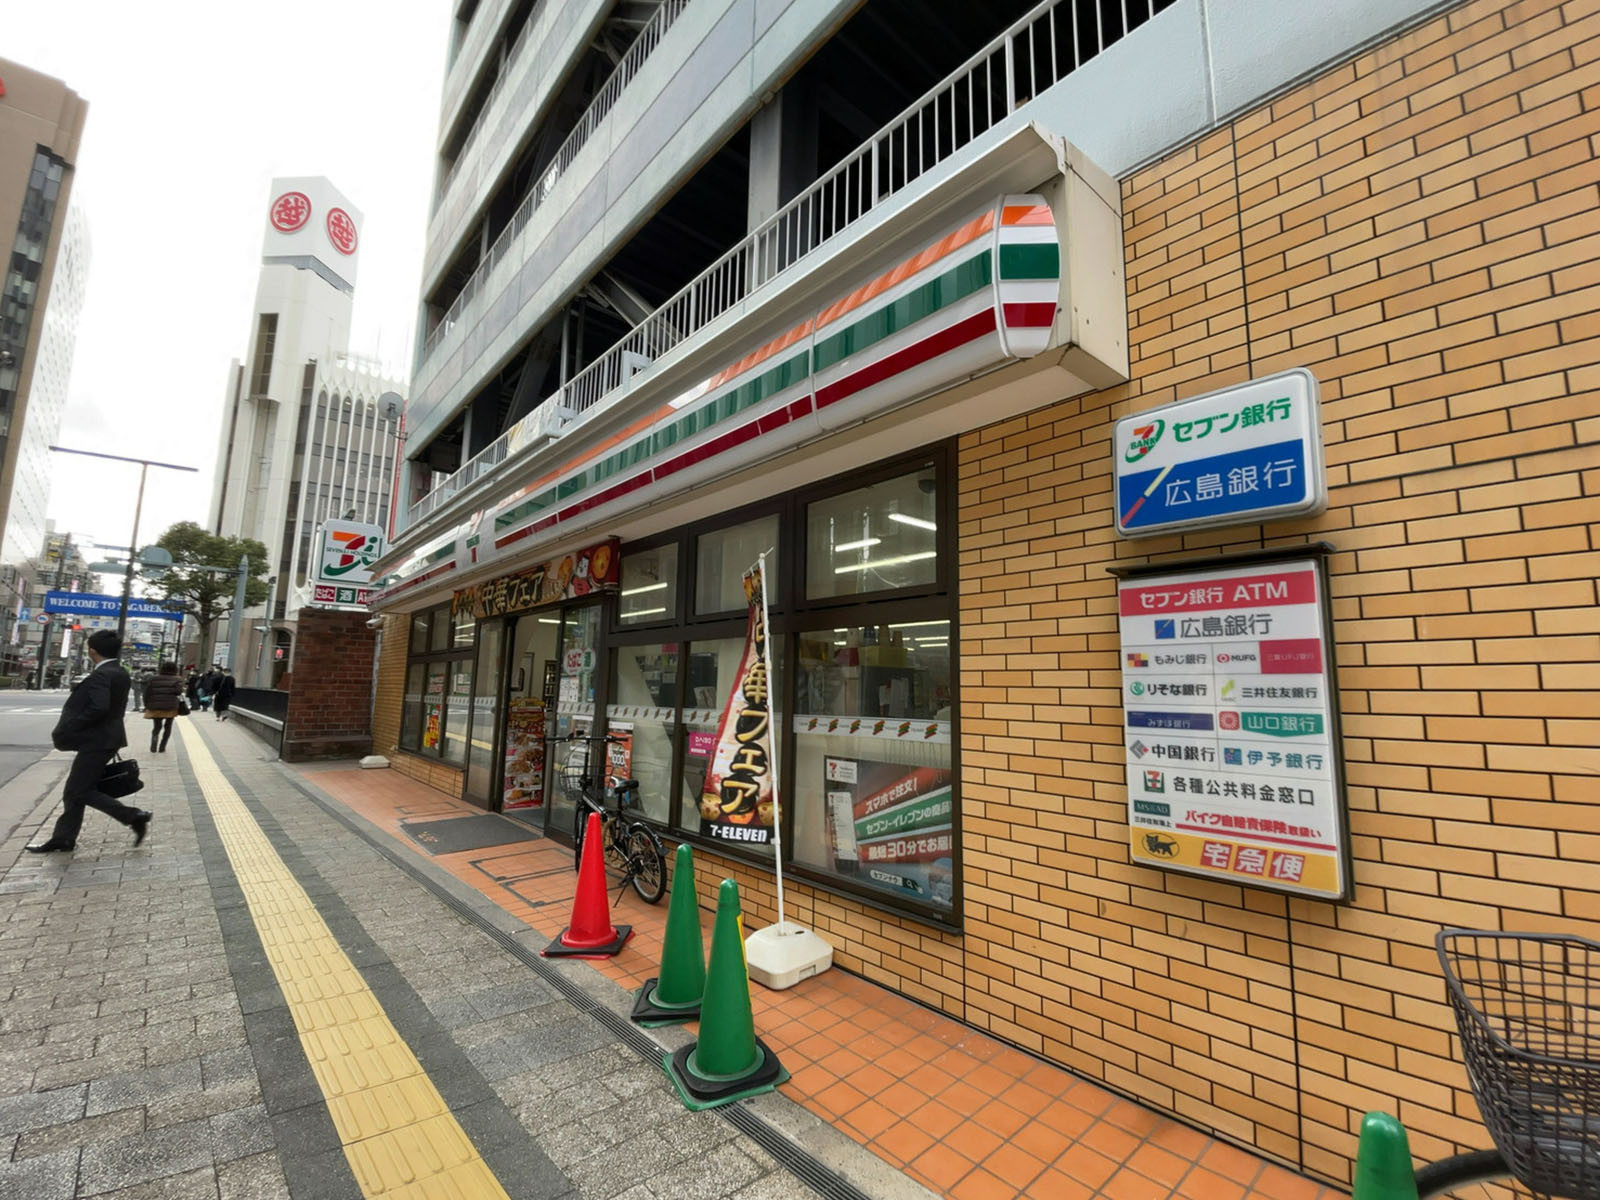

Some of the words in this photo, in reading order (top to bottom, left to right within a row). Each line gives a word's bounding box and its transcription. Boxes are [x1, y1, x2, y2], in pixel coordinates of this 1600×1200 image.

[1172, 397, 1292, 443] セブン銀行
[1129, 437, 1157, 451] BANK
[1164, 458, 1297, 507] 広島銀行
[49, 597, 100, 609] WELCOME
[100, 601, 116, 610] TO
[481, 570, 544, 616] 中華フェア
[1140, 587, 1224, 609] セブン銀行
[1233, 580, 1289, 601] ATM
[1180, 613, 1273, 639] 広島銀行
[1154, 653, 1208, 665] もみじ銀行
[1230, 654, 1257, 662] MUFG
[1147, 683, 1208, 696] りそな銀行
[1241, 686, 1318, 699] 三井住友銀行
[1247, 715, 1316, 732] 山口銀行
[1151, 743, 1216, 763] 中国銀行
[1246, 749, 1323, 771] 伊予銀行
[1173, 776, 1315, 806] 各種公共料金窓口
[868, 834, 952, 861] 最短30分でお届
[1203, 841, 1304, 881] 宅急便
